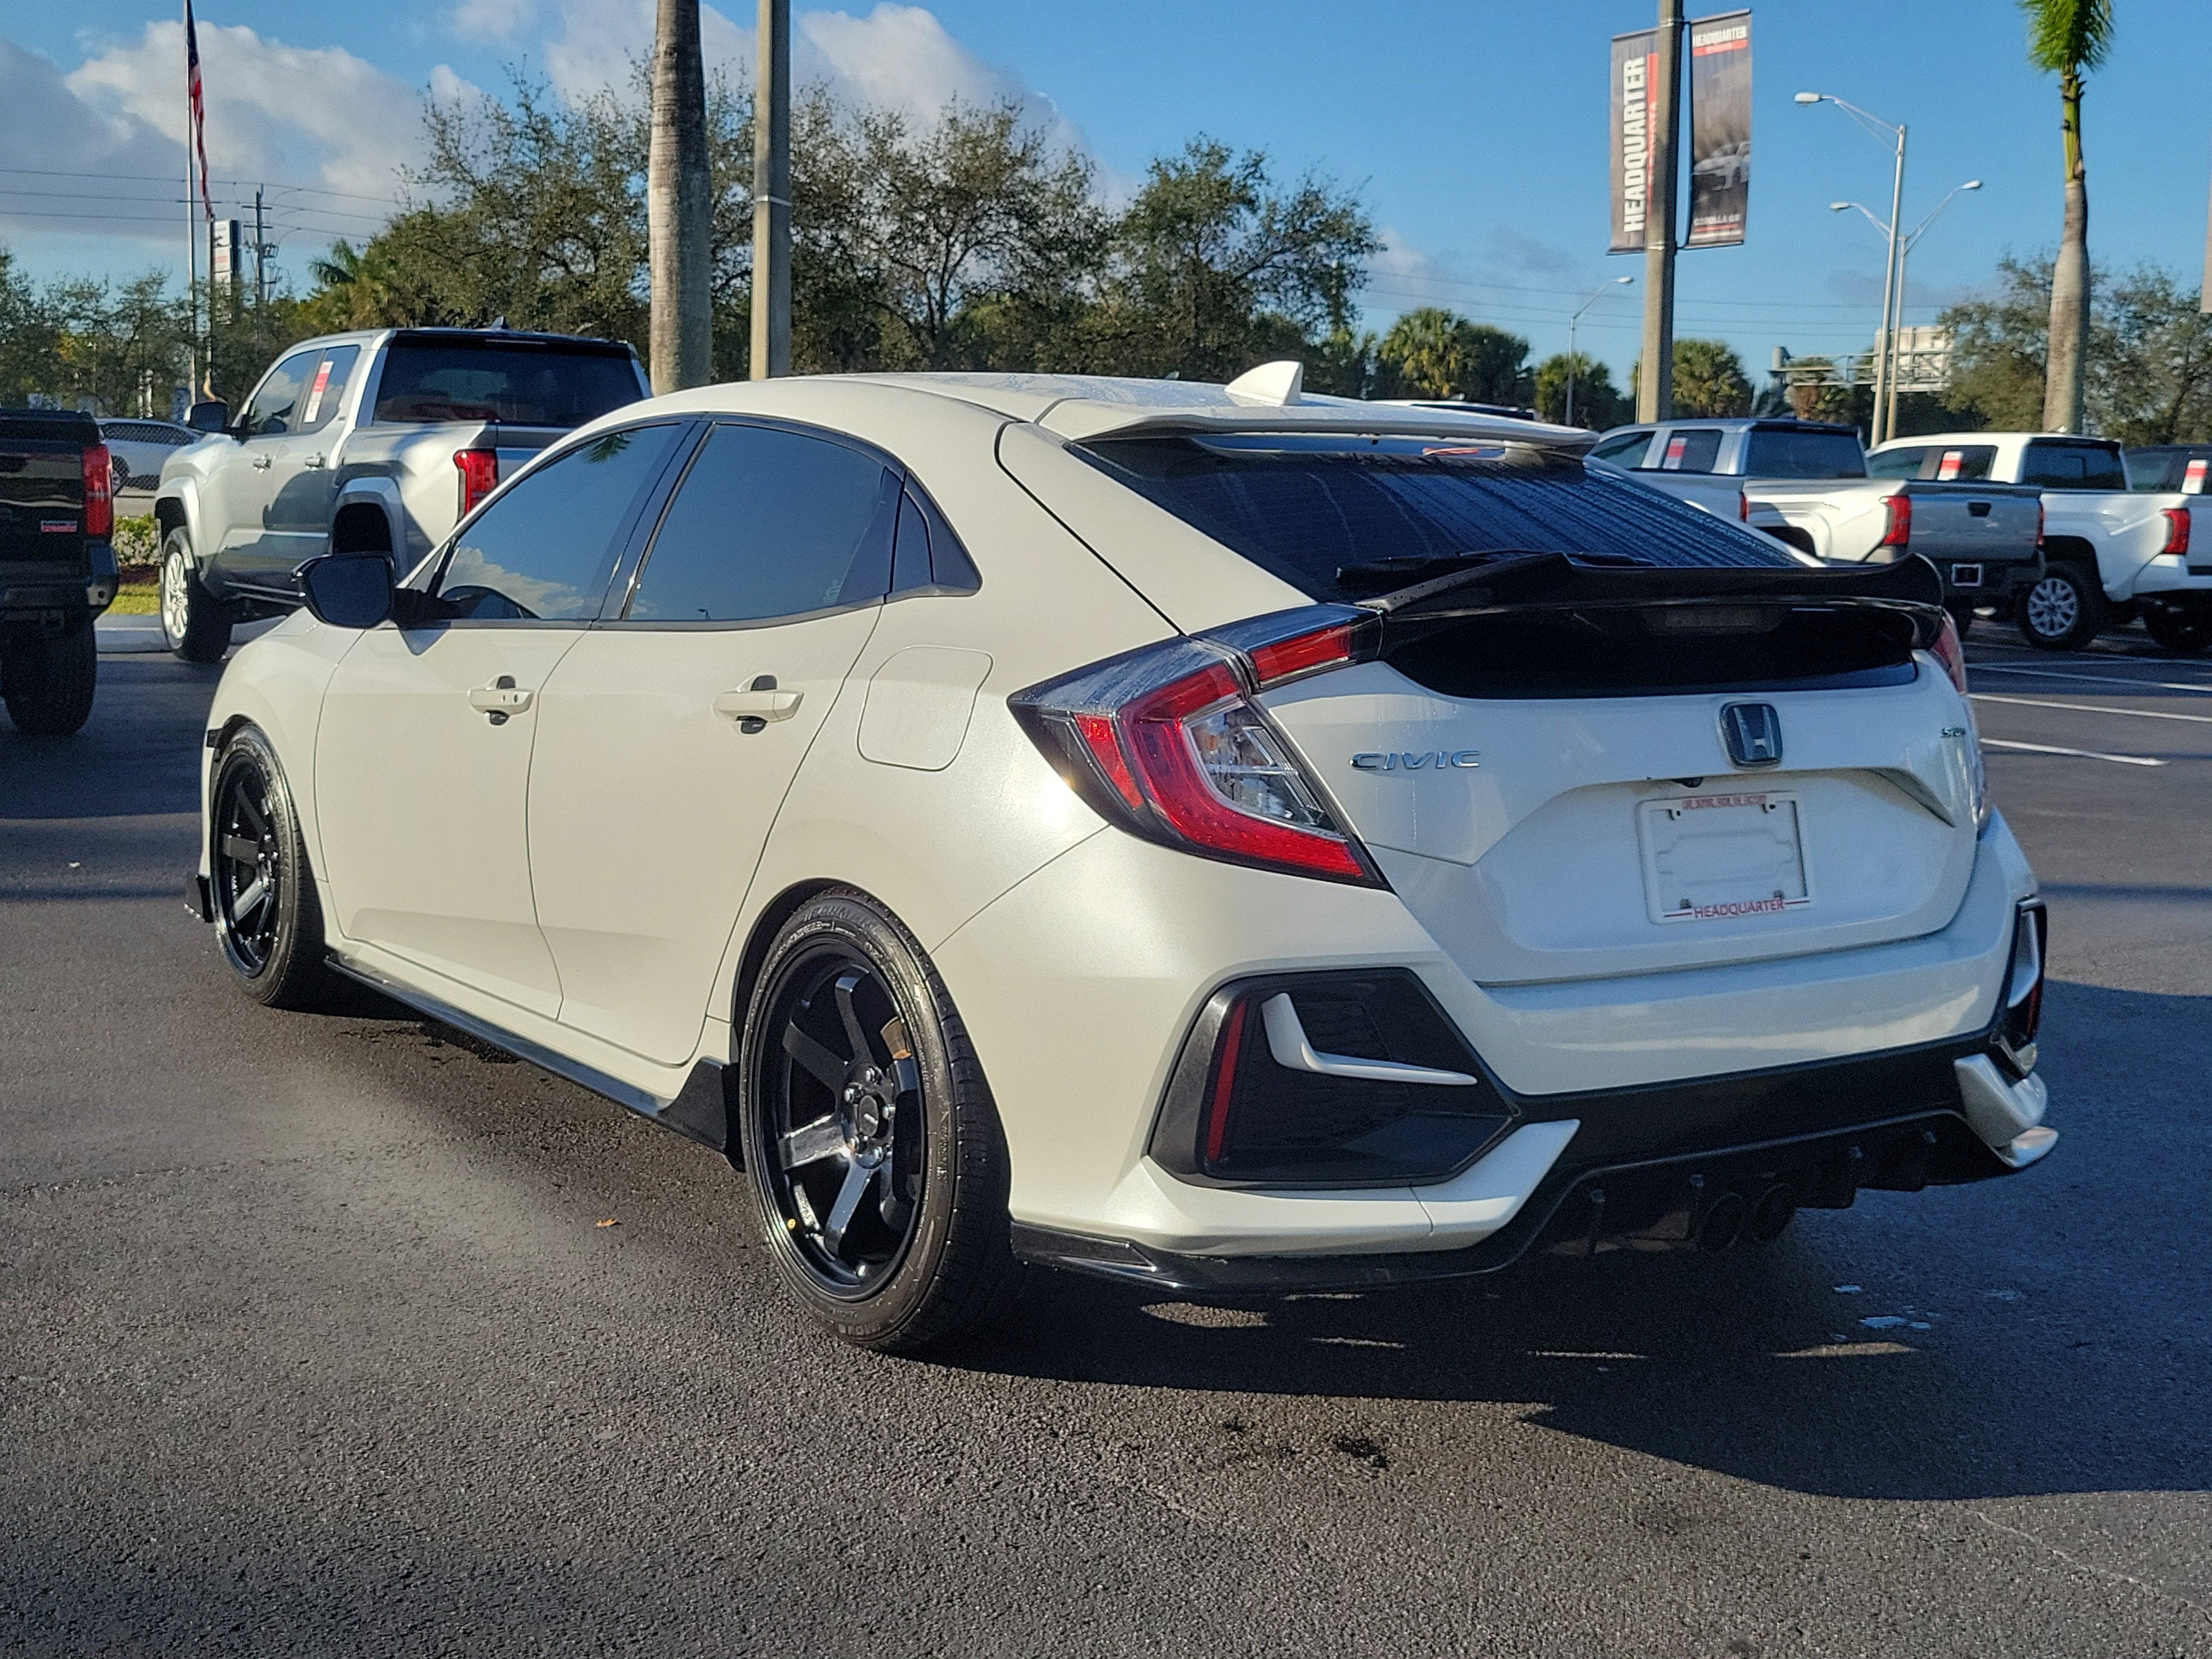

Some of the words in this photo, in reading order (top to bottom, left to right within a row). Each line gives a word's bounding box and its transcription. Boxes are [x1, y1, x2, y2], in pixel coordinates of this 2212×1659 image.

[1623, 56, 1647, 233] HEADQUARTER
[1348, 750, 1480, 770] CIVIC
[1694, 898, 1784, 919] HEADQUARTER
